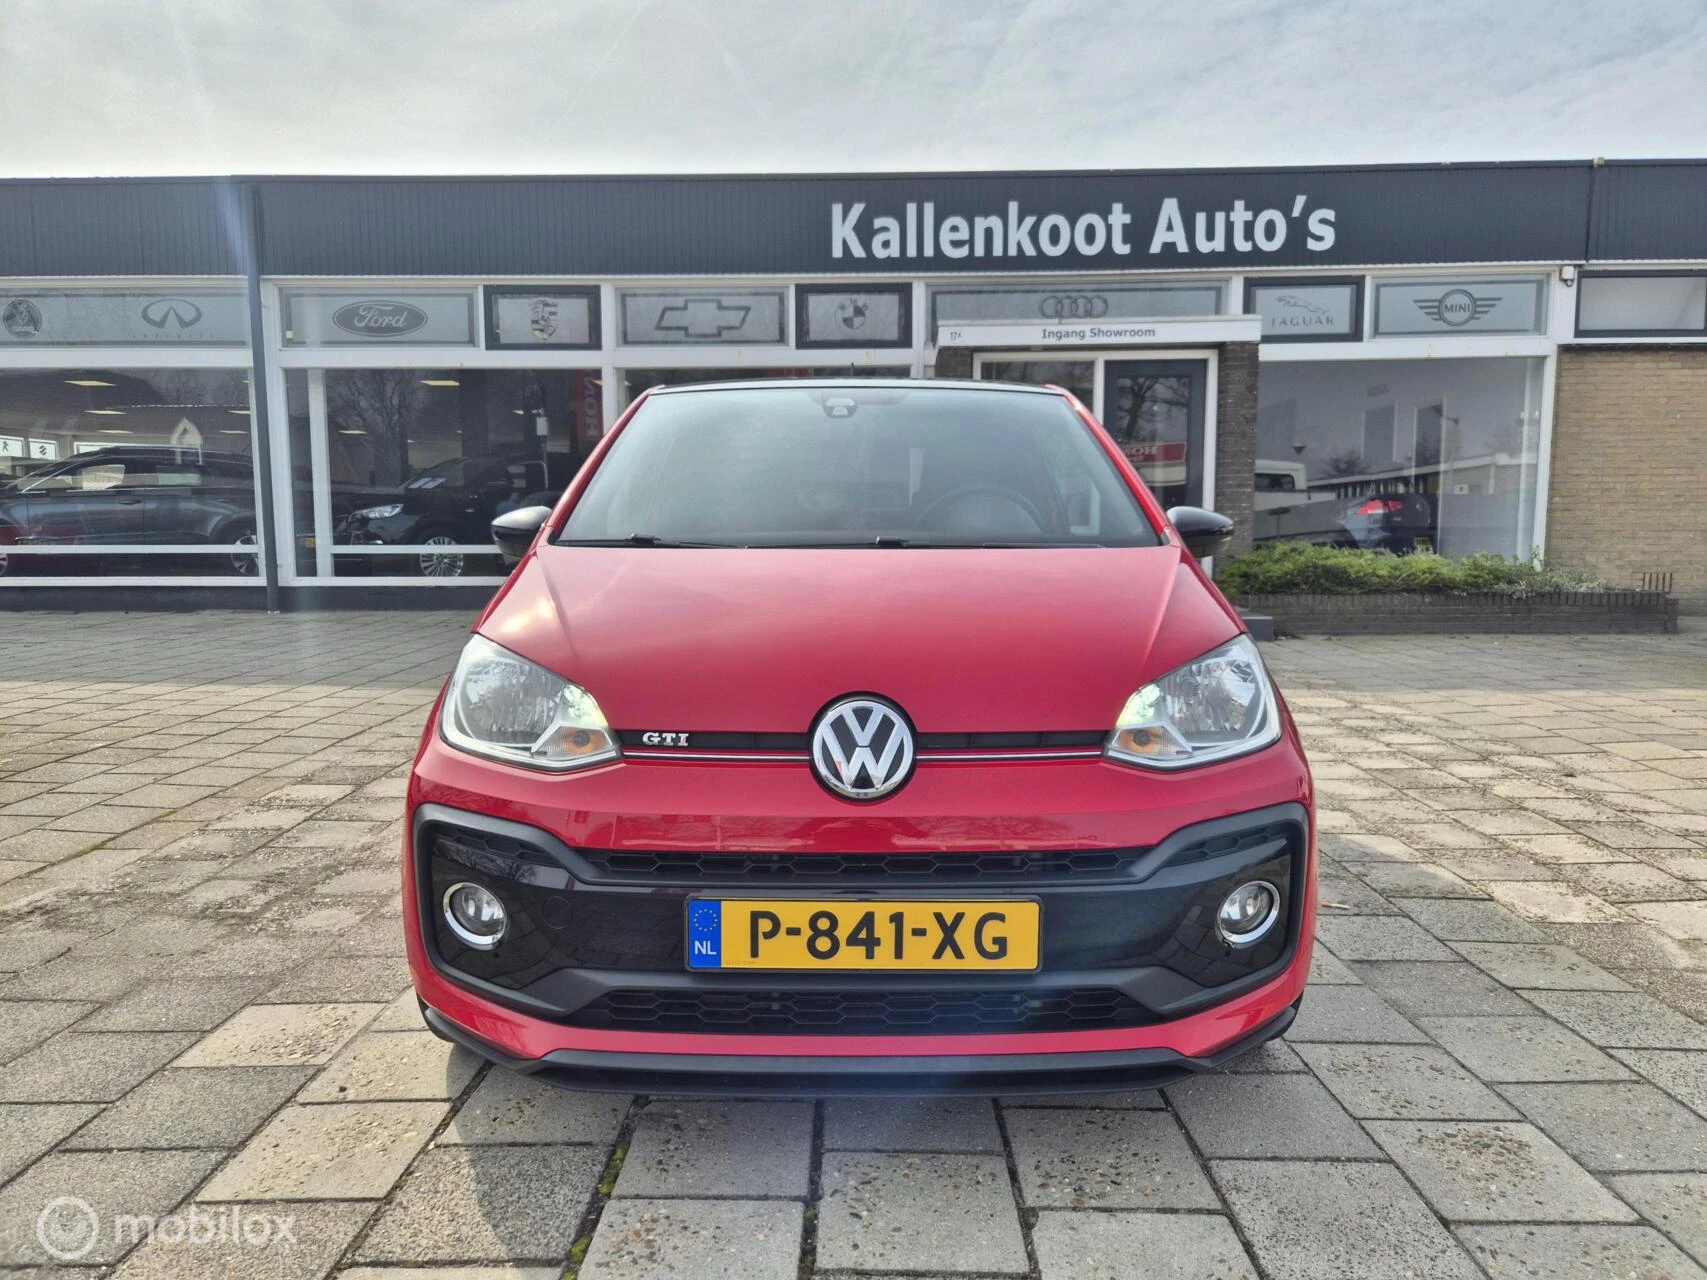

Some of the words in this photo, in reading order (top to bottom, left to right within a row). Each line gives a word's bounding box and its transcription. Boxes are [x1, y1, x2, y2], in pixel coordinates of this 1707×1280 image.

[831, 200, 1132, 259] Kallenkoot
[1148, 194, 1337, 254] Auto's
[354, 304, 409, 328] Ford
[1443, 303, 1471, 313] MINI
[1041, 327, 1086, 341] Ingang
[1089, 326, 1156, 339] Showroom
[642, 731, 689, 747] GTI
[749, 910, 1009, 961] P-841-XG
[693, 939, 717, 956] NL
